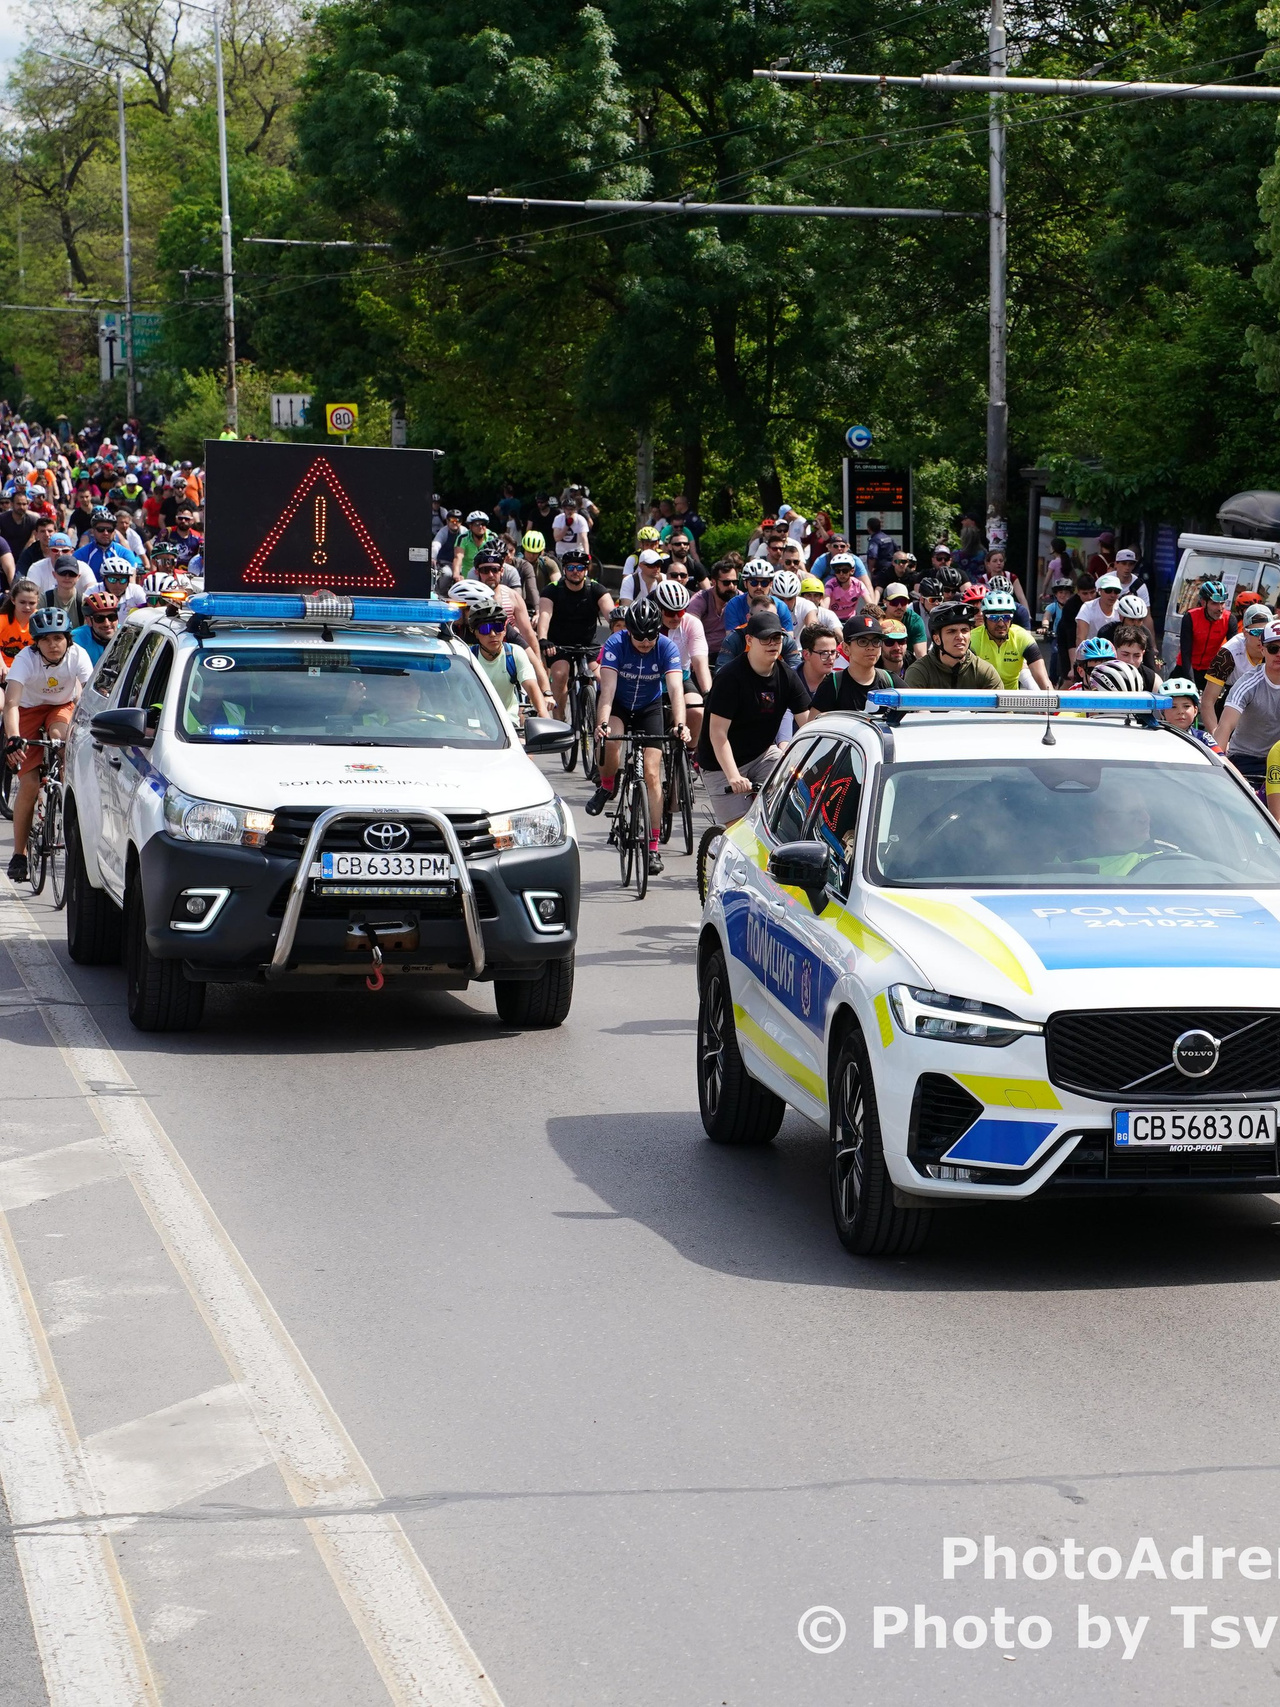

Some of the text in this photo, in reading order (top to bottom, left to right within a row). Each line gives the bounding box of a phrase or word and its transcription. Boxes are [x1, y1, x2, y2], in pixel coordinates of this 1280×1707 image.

[335, 413, 350, 425] 80
[211, 657, 228, 668] 9
[339, 779, 461, 789] MUNICIPALITY
[337, 857, 445, 876] CB 6333 PM
[1031, 906, 1243, 919] POLICE
[1083, 919, 1219, 928] 24-1022
[746, 912, 795, 997] ПОЛИЦИЯ
[1133, 1115, 1166, 1141] CB
[1171, 1115, 1233, 1140] 5683
[1117, 1133, 1128, 1141] BG
[1169, 1144, 1223, 1152] MOTO-PFOHE
